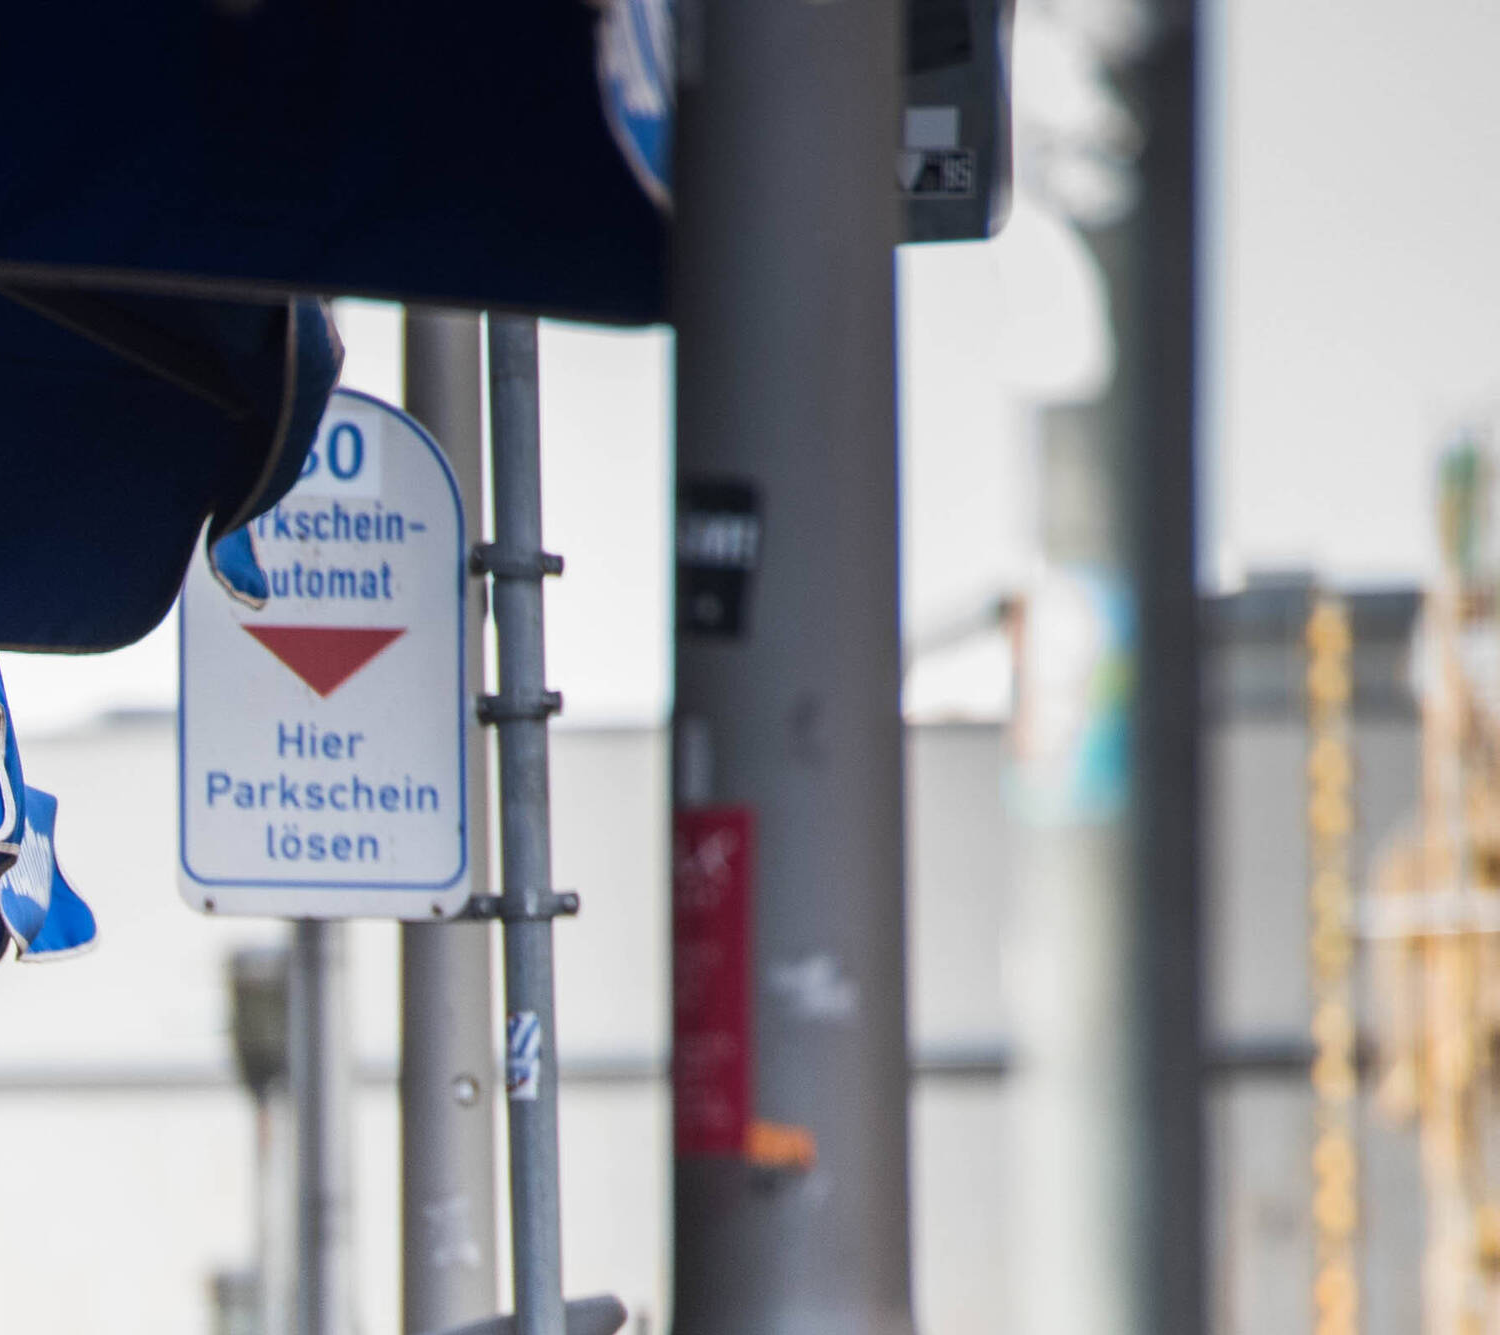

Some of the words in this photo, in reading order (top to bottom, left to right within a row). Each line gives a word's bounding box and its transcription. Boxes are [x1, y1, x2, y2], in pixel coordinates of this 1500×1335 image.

[257, 500, 427, 543] rkschein-
[268, 562, 394, 600] utomat
[277, 721, 365, 760] Hier
[206, 770, 440, 812] Parkschein
[266, 822, 381, 862] lösen
